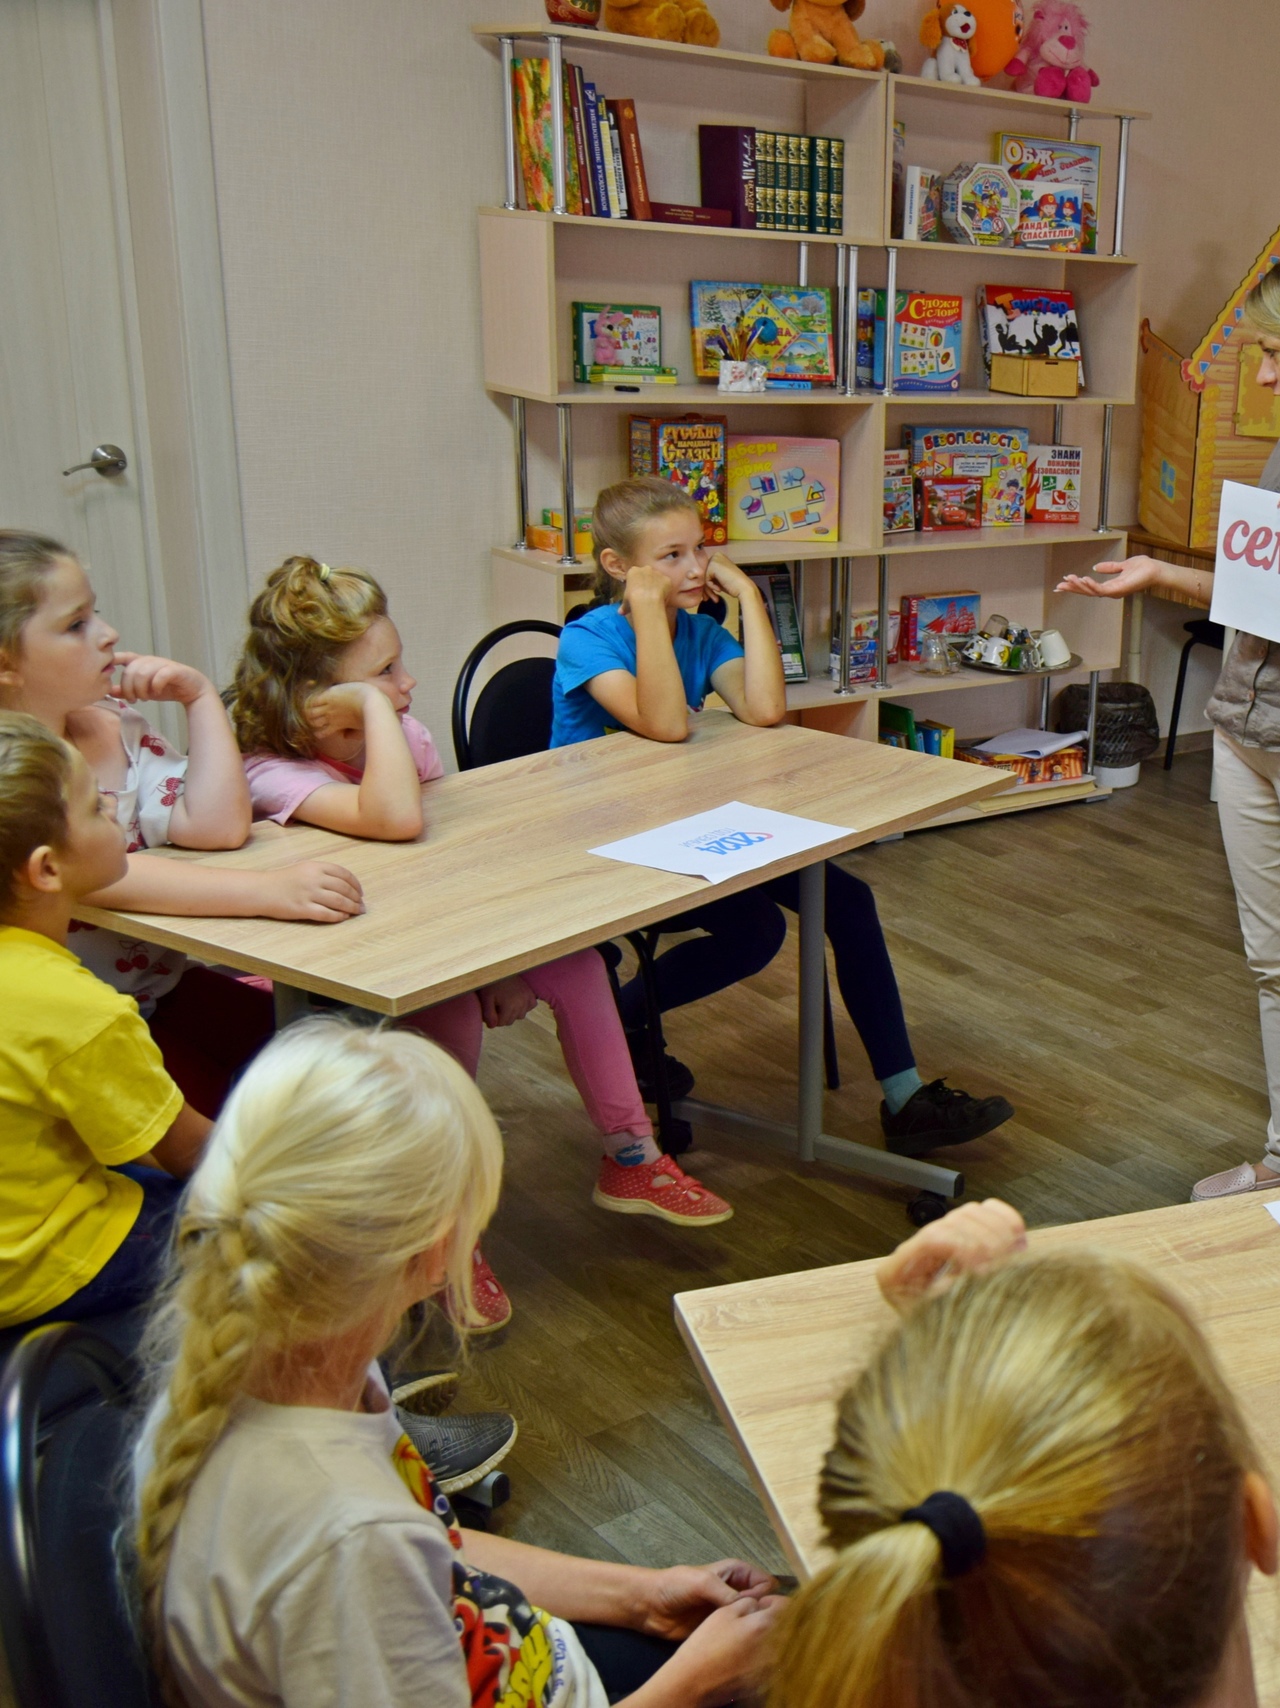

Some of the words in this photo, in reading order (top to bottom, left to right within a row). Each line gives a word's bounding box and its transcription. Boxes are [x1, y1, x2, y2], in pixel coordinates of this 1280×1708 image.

[589, 109, 602, 163] ЭНЦИКЛОПЕДИЯ
[1006, 140, 1054, 166] ОБЖ
[597, 165, 608, 211] ВОЛОГОДСКАЯ
[1018, 222, 1048, 231] МАНДА
[1022, 228, 1075, 241] СПАСАТЕЛЕЙ
[909, 298, 959, 319] Сложи
[927, 307, 959, 318] слово
[663, 425, 722, 442] РУССКИЕ
[923, 431, 1021, 451] БЕЗОПАСНОСТЬ
[662, 442, 721, 462] СКАЗКИ
[727, 442, 777, 461] дбери
[1051, 449, 1081, 460] ЗНАКИ
[1034, 467, 1080, 475] БЕЗОПАСНОСТИ
[910, 600, 918, 614] 160
[695, 832, 766, 855] 2024
